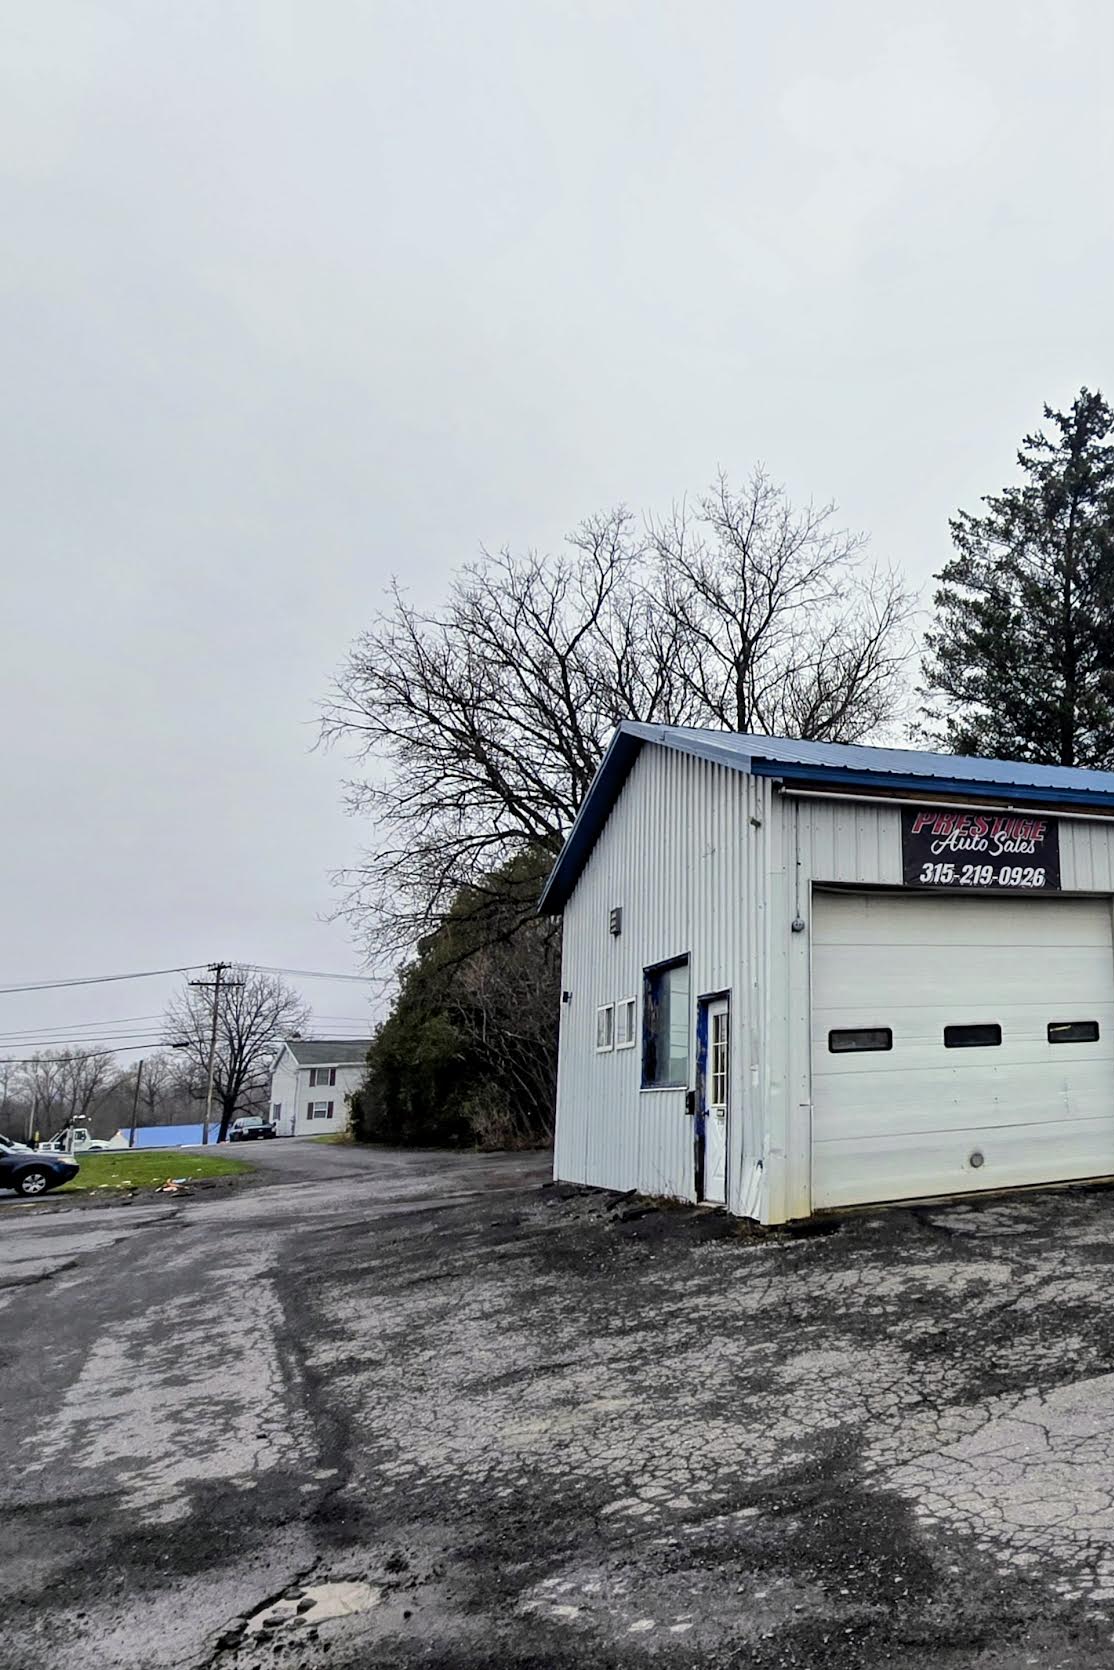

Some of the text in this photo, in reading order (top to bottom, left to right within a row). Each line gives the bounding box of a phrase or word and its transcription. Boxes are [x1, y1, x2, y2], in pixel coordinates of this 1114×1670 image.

[911, 810, 1048, 842] PRESTIGE
[930, 828, 1035, 856] Auto Sales
[919, 862, 1046, 887] 315-219-0926
